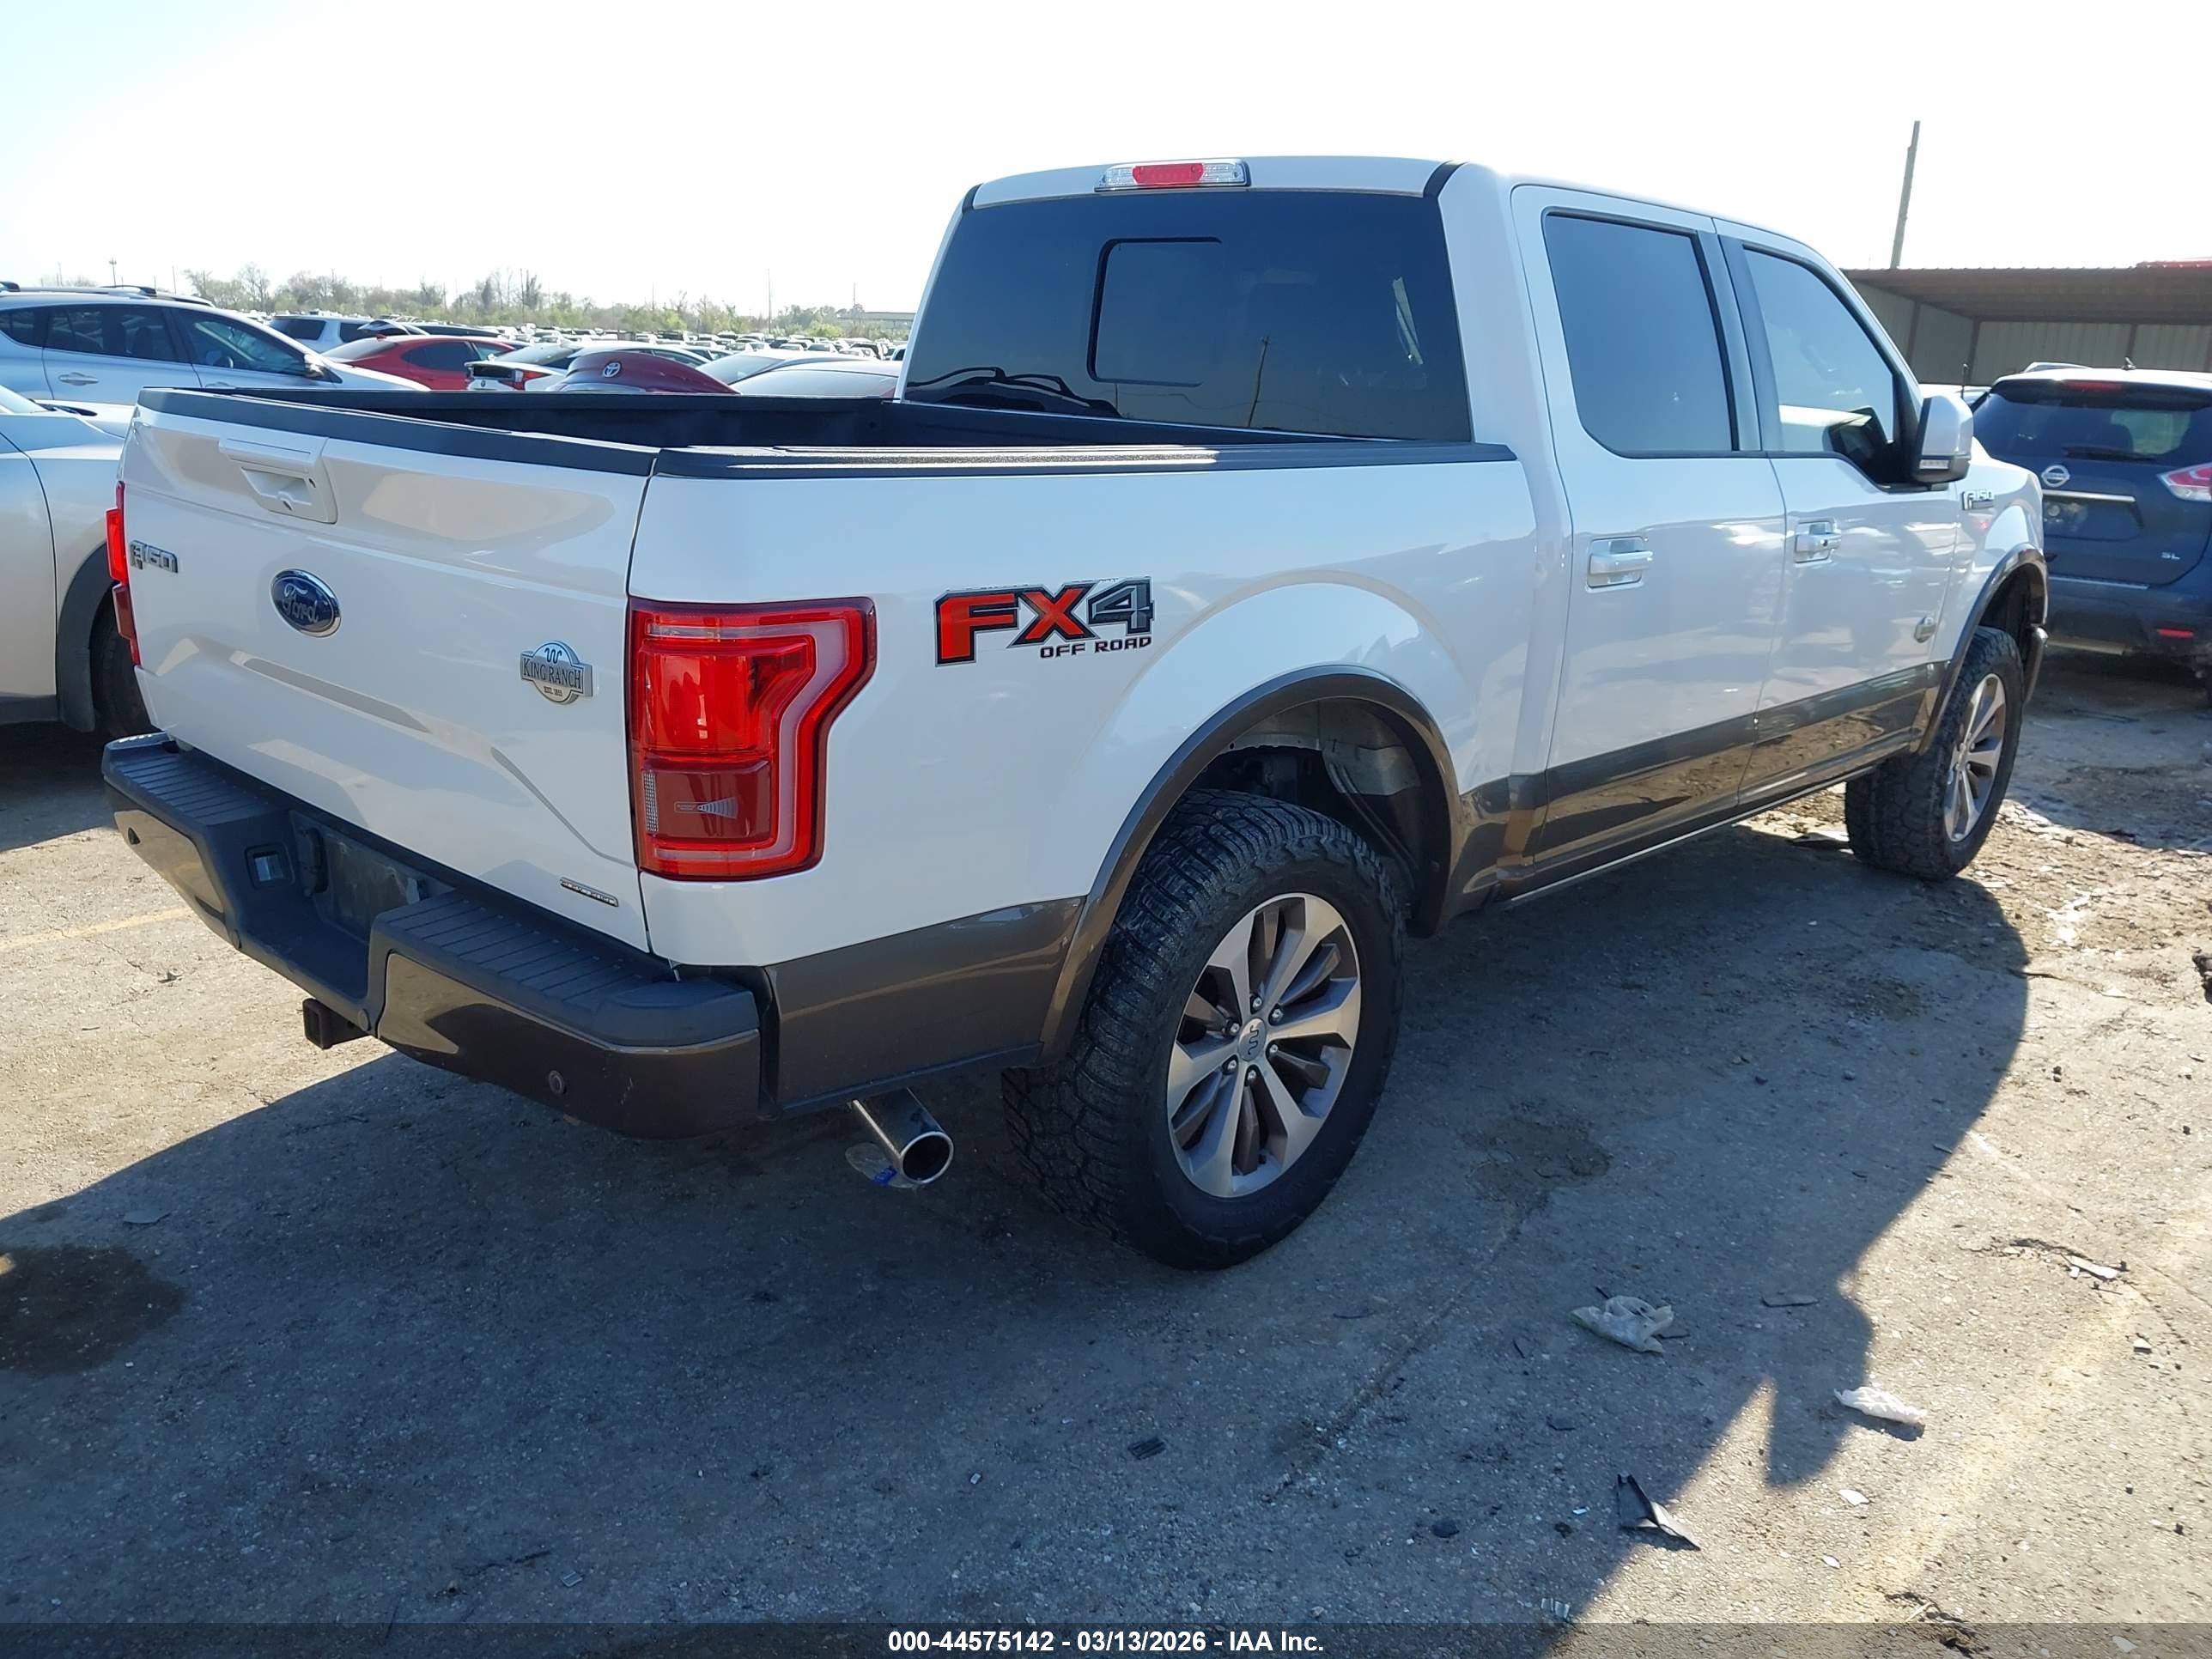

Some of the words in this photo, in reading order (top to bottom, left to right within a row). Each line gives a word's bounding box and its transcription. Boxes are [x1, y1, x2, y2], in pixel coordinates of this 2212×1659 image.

[933, 576, 1155, 667] FX4
[1039, 643, 1087, 659] OFF
[1094, 635, 1153, 654] ROAD
[522, 657, 547, 681] KING
[548, 665, 582, 690] RANCH
